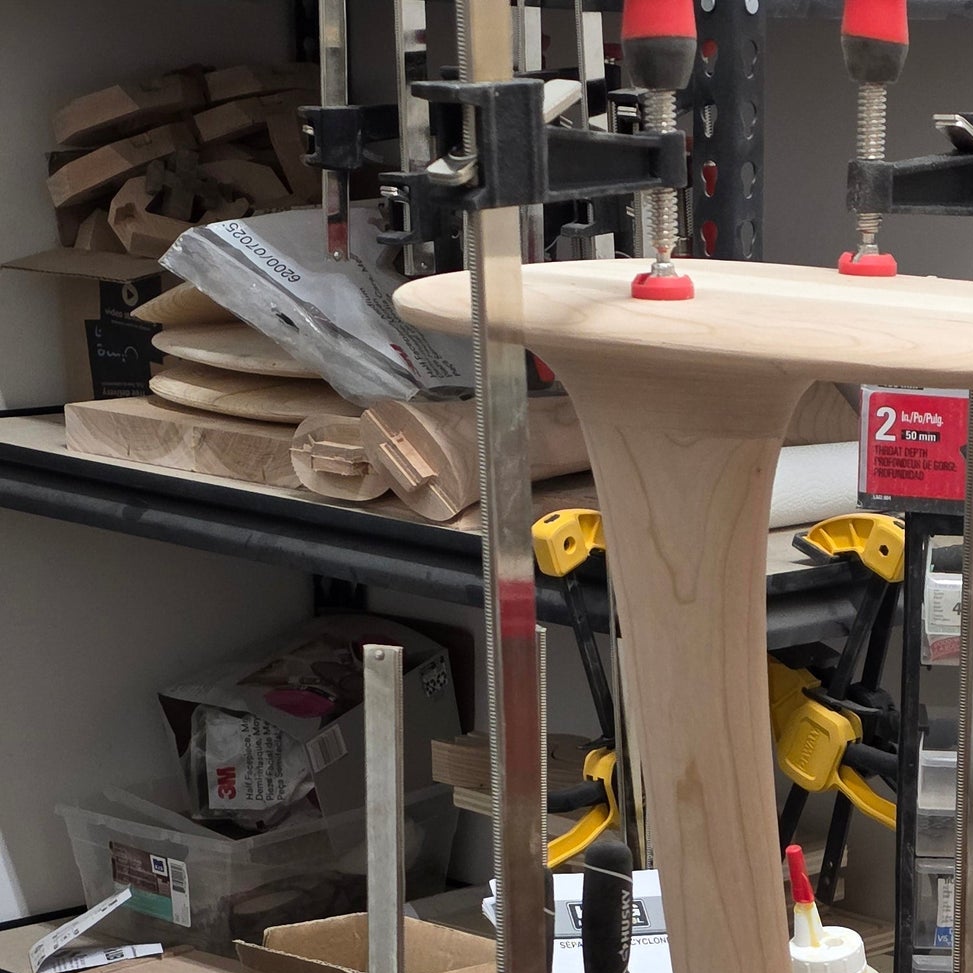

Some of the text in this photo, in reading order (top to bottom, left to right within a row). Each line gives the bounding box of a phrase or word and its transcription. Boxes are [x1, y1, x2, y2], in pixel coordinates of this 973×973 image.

[875, 406, 897, 442] 2
[905, 431, 937, 442] 50 mm
[874, 445, 928, 458] THROAT DEPTH
[216, 767, 237, 800] 3M
[621, 889, 631, 943] HUSKY
[631, 937, 667, 946] CYCLON
